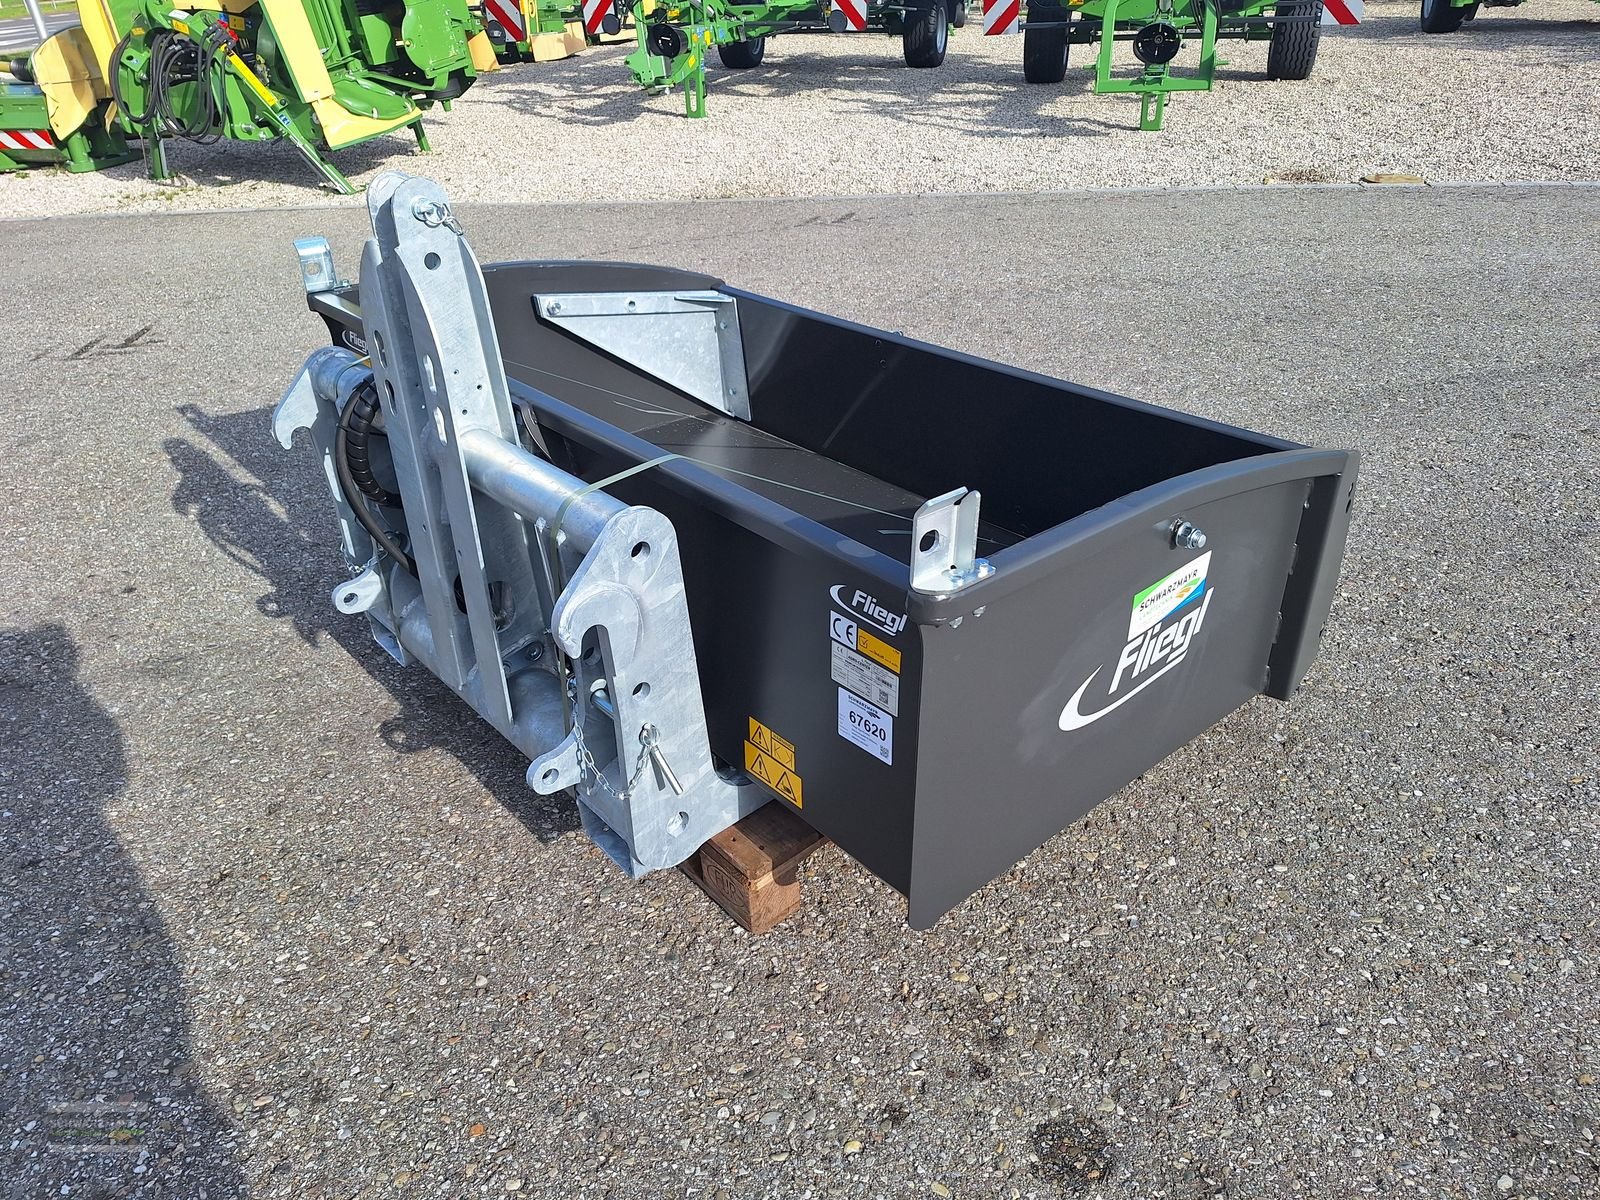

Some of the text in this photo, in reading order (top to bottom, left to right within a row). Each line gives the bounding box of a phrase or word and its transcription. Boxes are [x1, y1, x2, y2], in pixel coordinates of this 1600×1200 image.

[1139, 569, 1198, 612] SCHWARZMAYR
[851, 589, 908, 633] Fliegl
[833, 617, 854, 645] CE
[1108, 587, 1215, 695] Fliegl
[848, 694, 879, 714] SCHWARZMAYR
[849, 710, 887, 741] 67620
